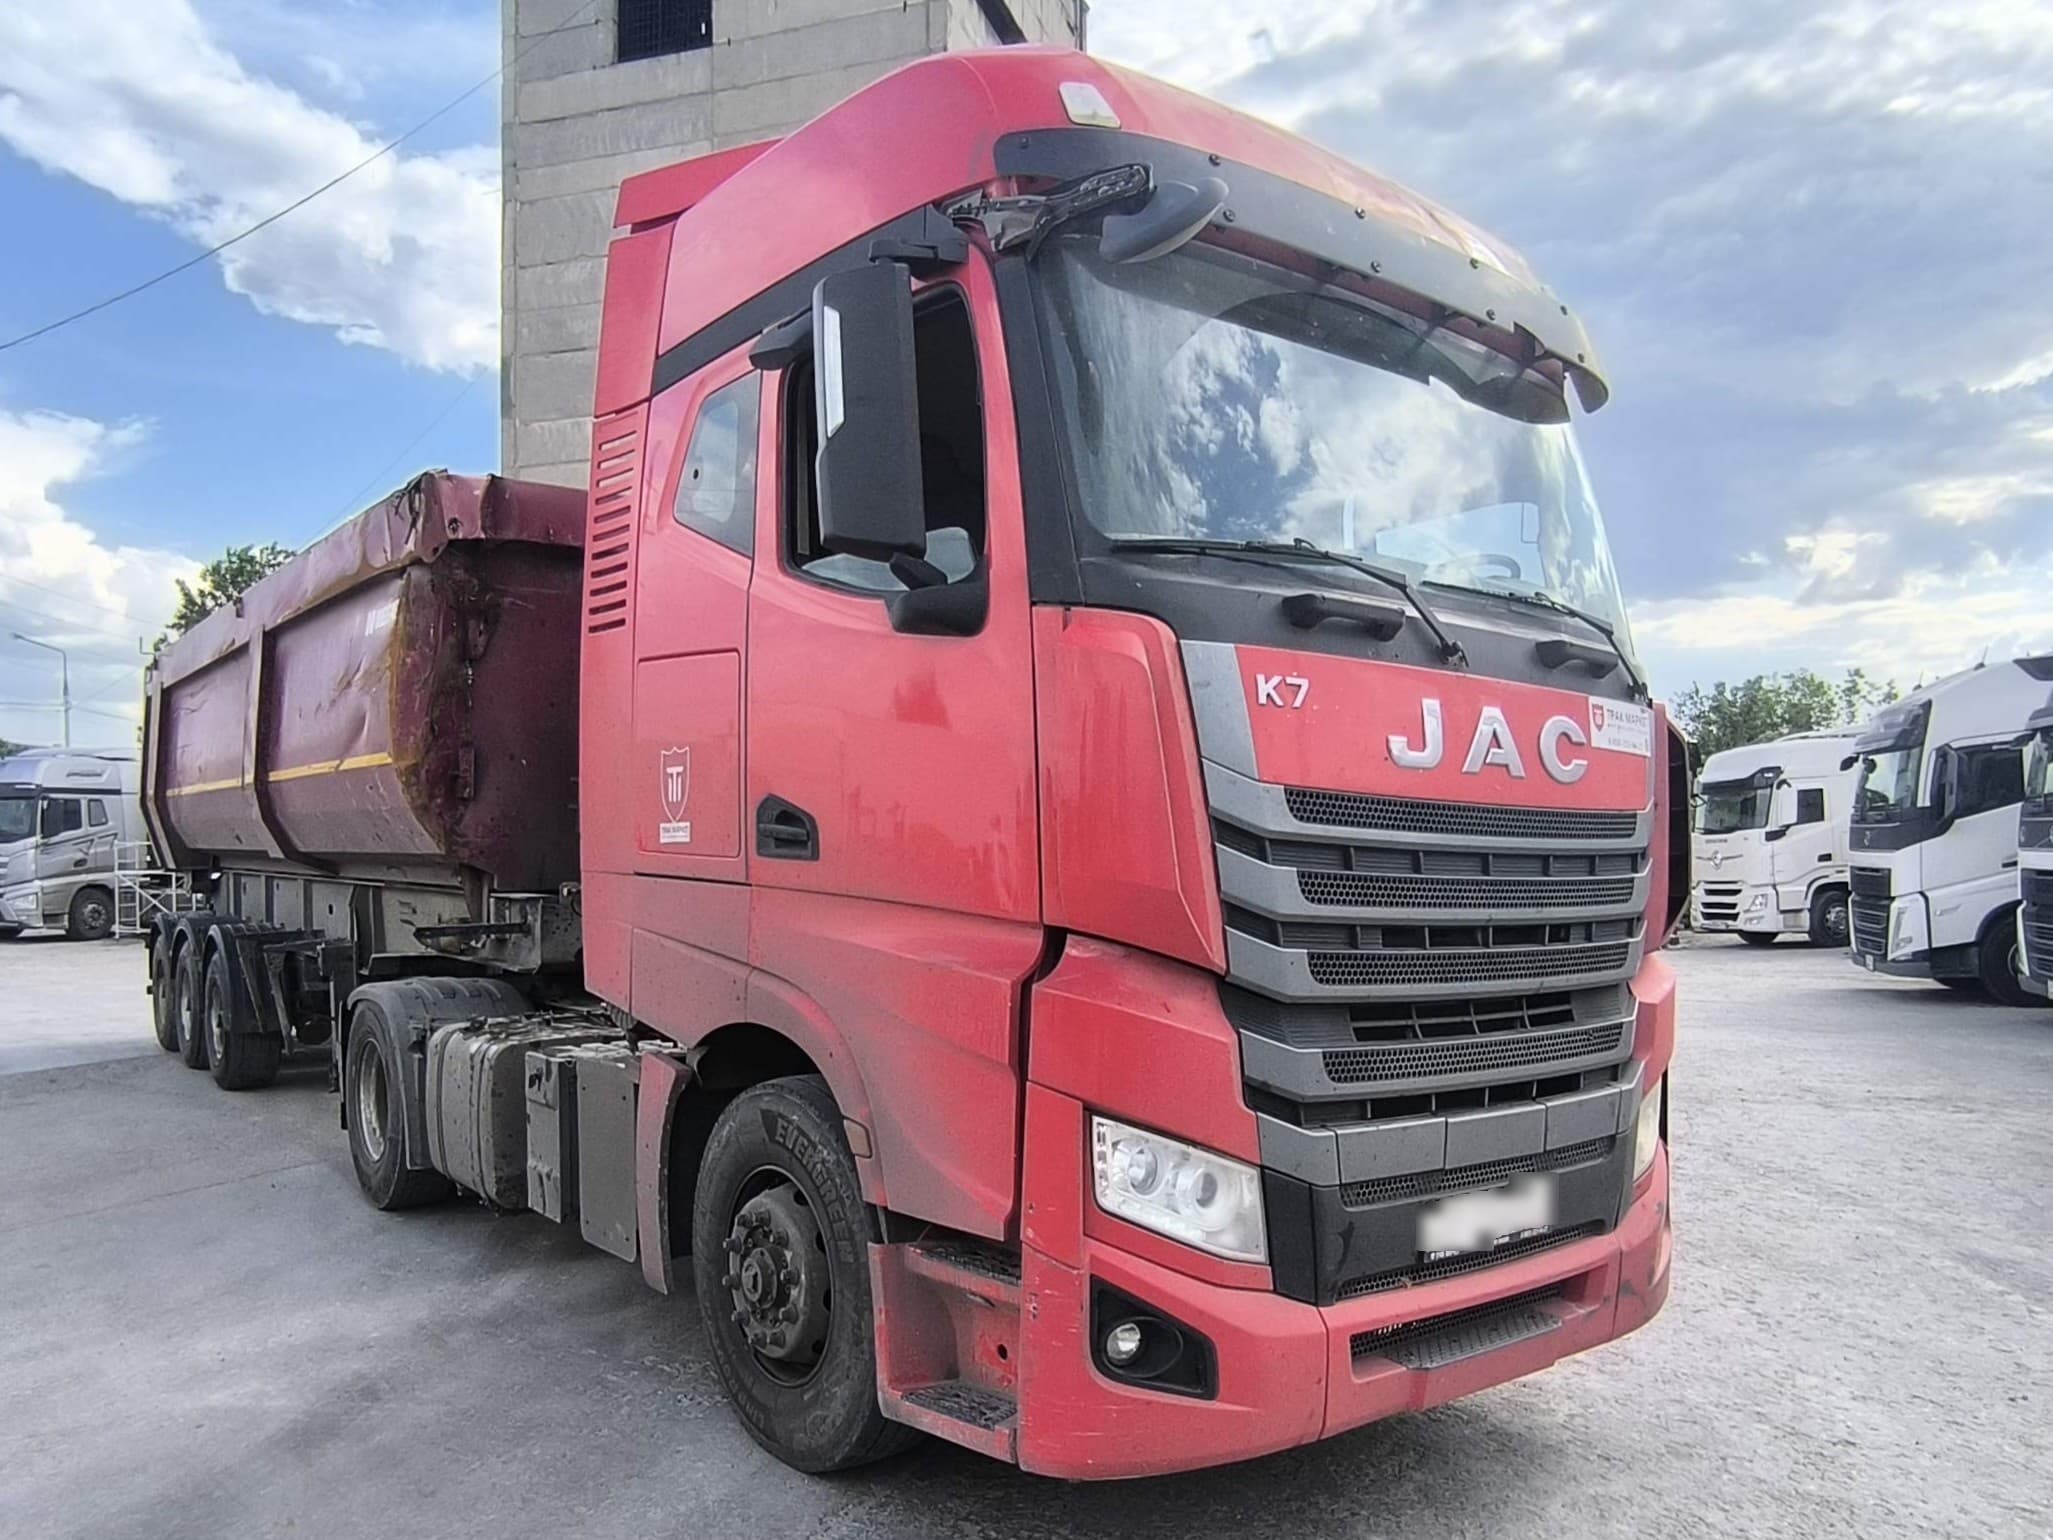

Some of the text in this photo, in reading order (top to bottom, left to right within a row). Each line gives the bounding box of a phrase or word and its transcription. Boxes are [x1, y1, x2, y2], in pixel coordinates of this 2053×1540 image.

[1255, 673, 1310, 709] K7
[1387, 698, 1589, 784] JAC
[775, 1117, 855, 1264] EVERGREEN
